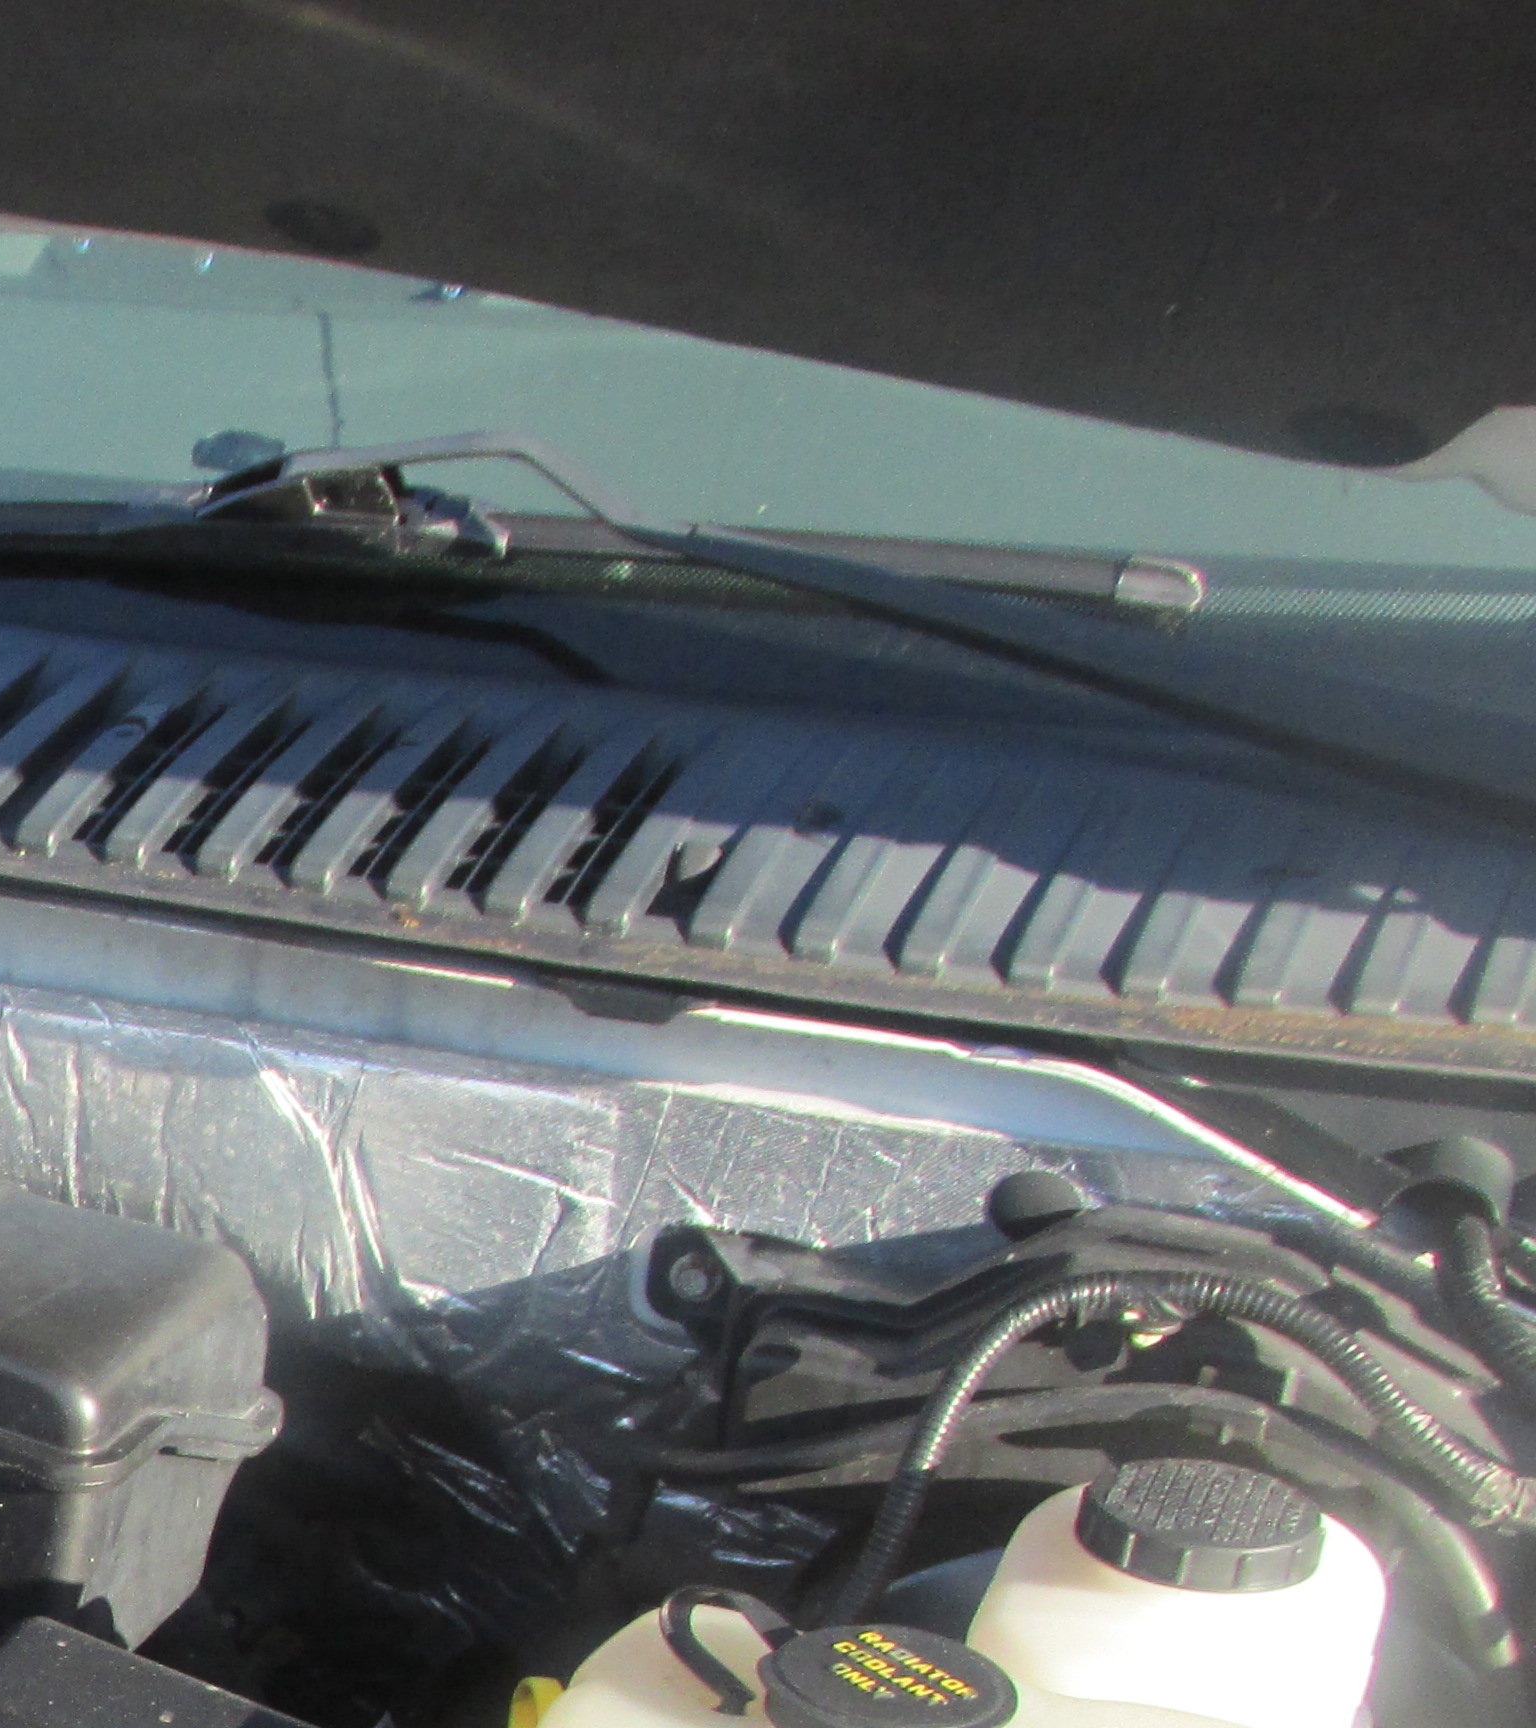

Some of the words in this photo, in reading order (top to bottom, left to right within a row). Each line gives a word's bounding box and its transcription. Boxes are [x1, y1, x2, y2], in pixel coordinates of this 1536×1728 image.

[832, 1640, 949, 1706] COOLANT
[832, 1661, 896, 1700] ONLY
[858, 1631, 977, 1700] RADIATOR
